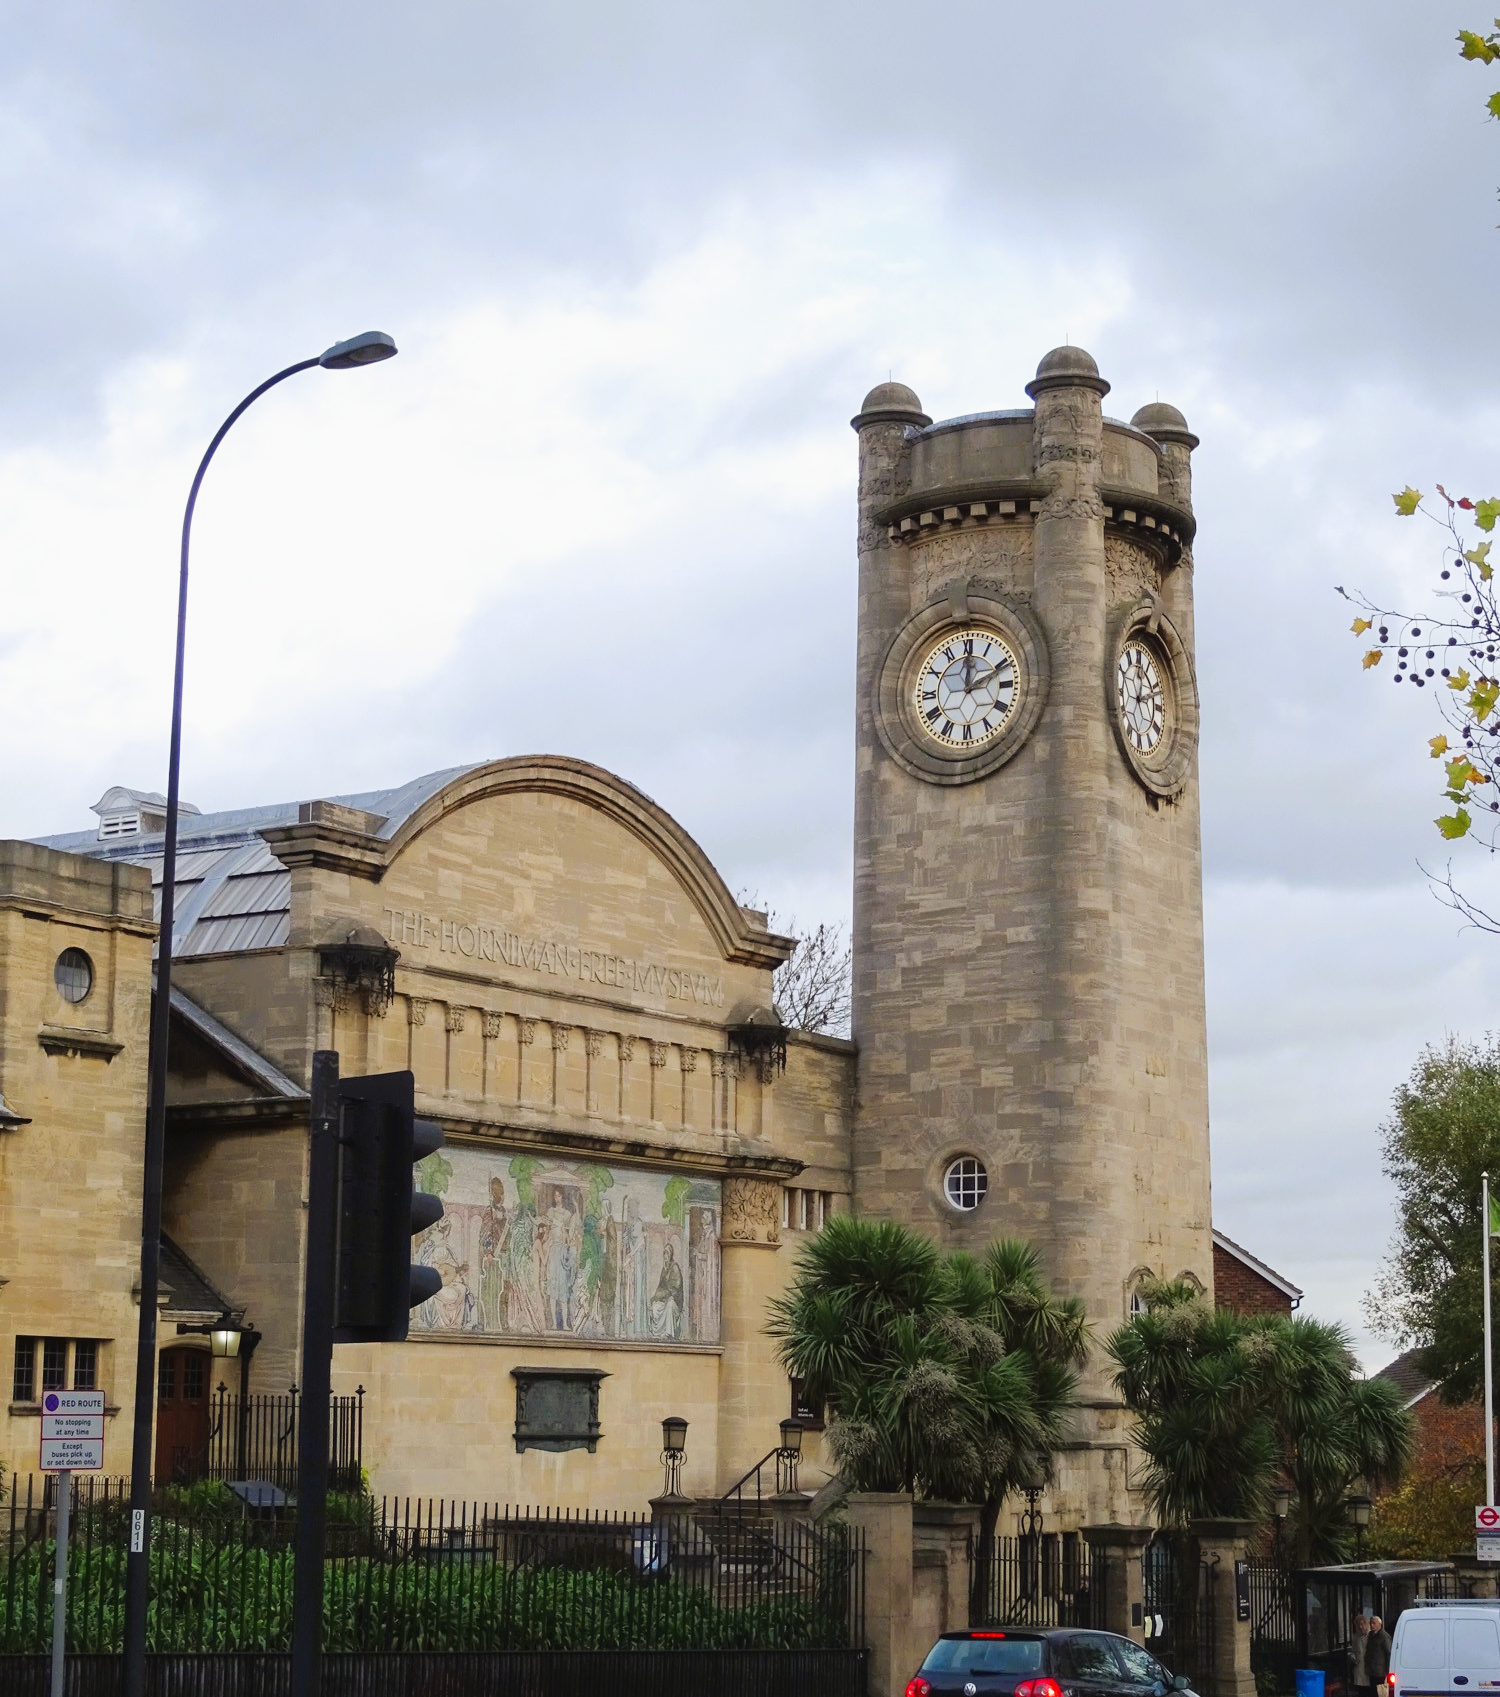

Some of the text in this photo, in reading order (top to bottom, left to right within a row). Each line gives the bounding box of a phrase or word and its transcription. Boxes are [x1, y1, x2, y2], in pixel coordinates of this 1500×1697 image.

[927, 666, 942, 679] X
[383, 906, 429, 948] THE
[440, 919, 568, 977] HORNIMAN
[579, 949, 625, 989] FREE
